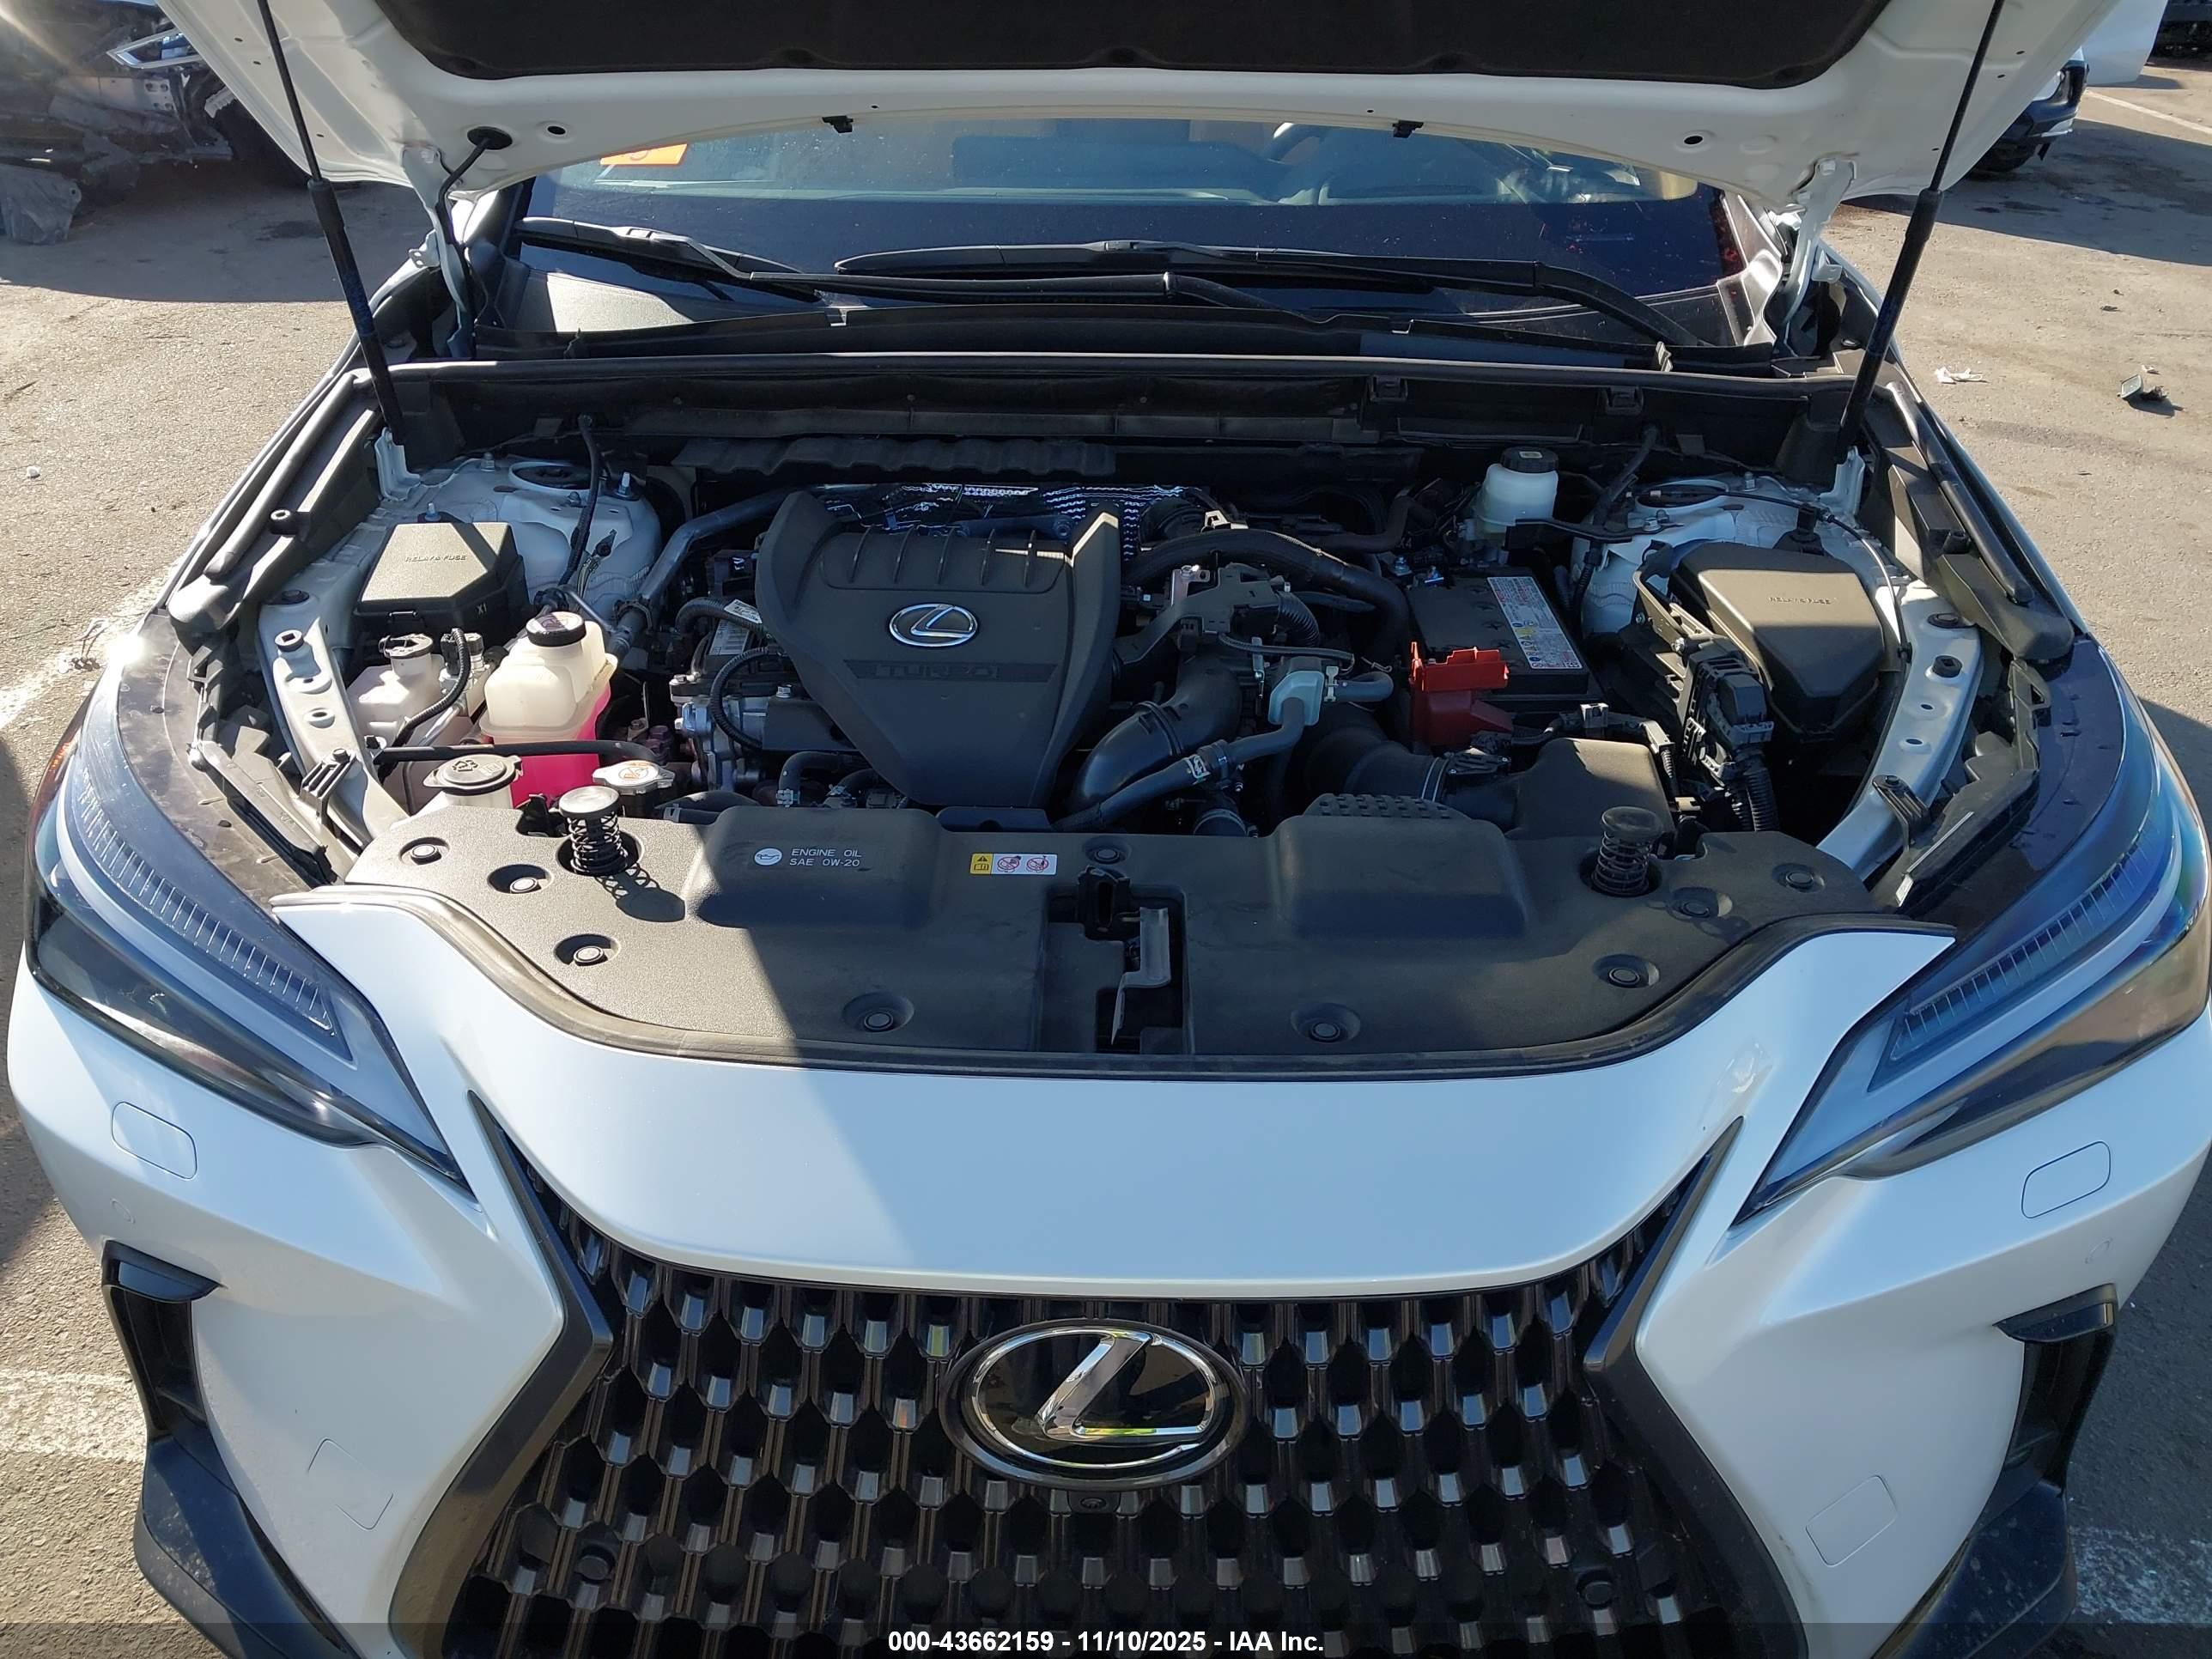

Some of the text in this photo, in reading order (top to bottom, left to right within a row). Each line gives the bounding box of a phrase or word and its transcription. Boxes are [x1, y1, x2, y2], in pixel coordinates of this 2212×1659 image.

[791, 848, 862, 858] ENGINE OIL
[789, 858, 815, 866] SAE
